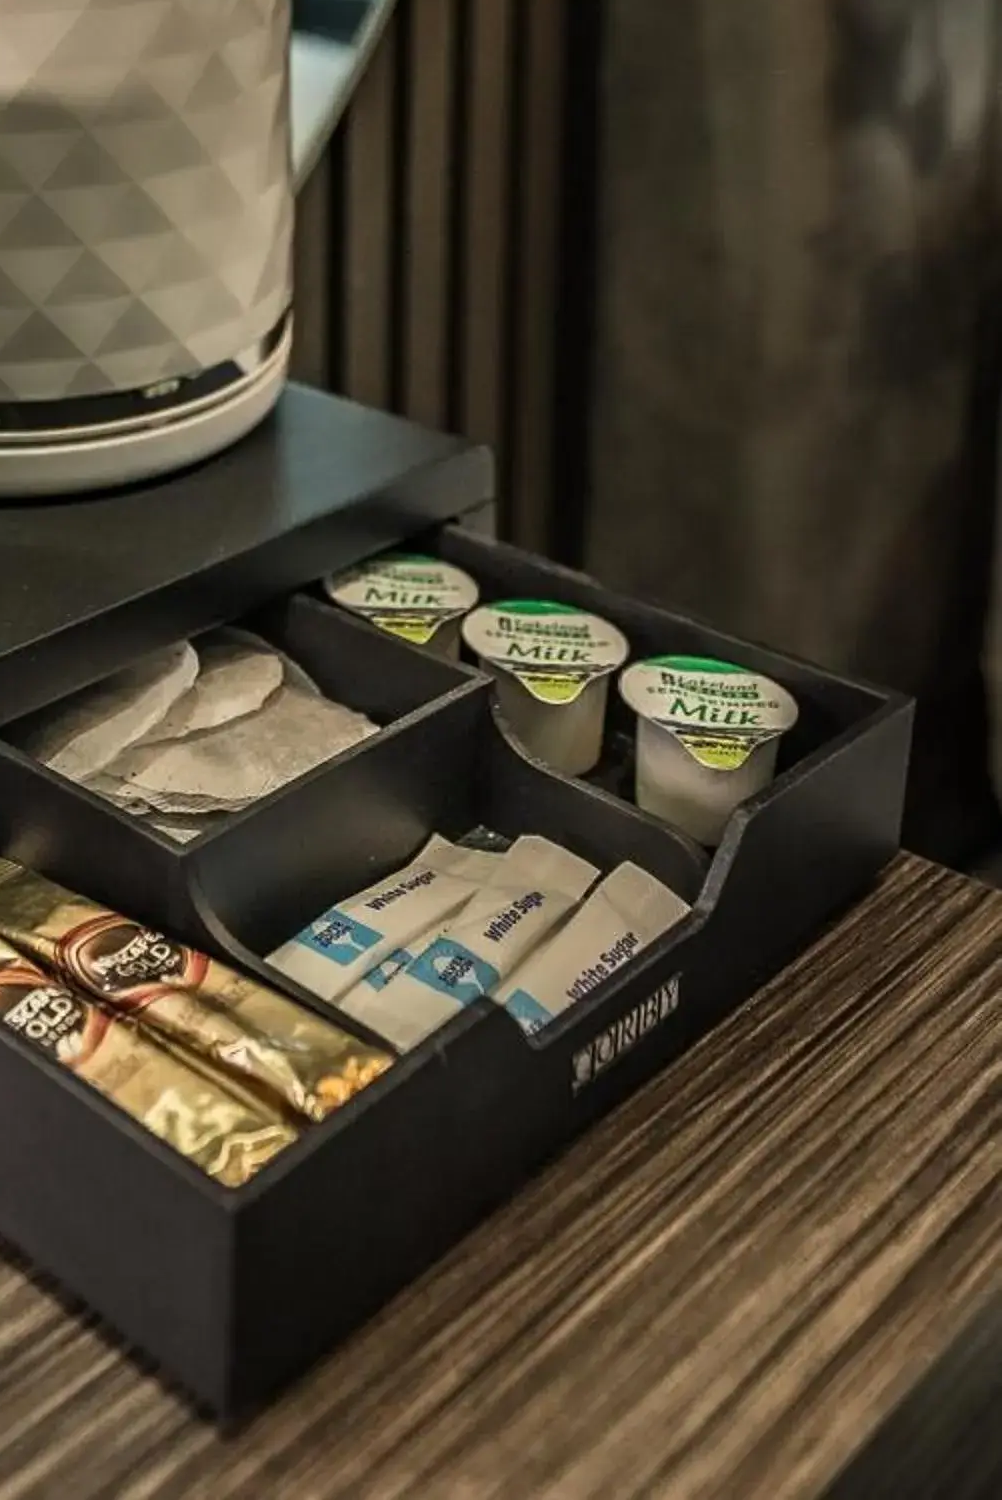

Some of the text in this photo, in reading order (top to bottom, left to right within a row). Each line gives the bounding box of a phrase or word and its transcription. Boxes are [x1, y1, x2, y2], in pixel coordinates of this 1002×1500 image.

[506, 642, 593, 663] Milk
[669, 697, 761, 725] Milk
[483, 908, 522, 942] White
[566, 931, 640, 1000] White Sugar
[26, 998, 73, 1038] OLD
